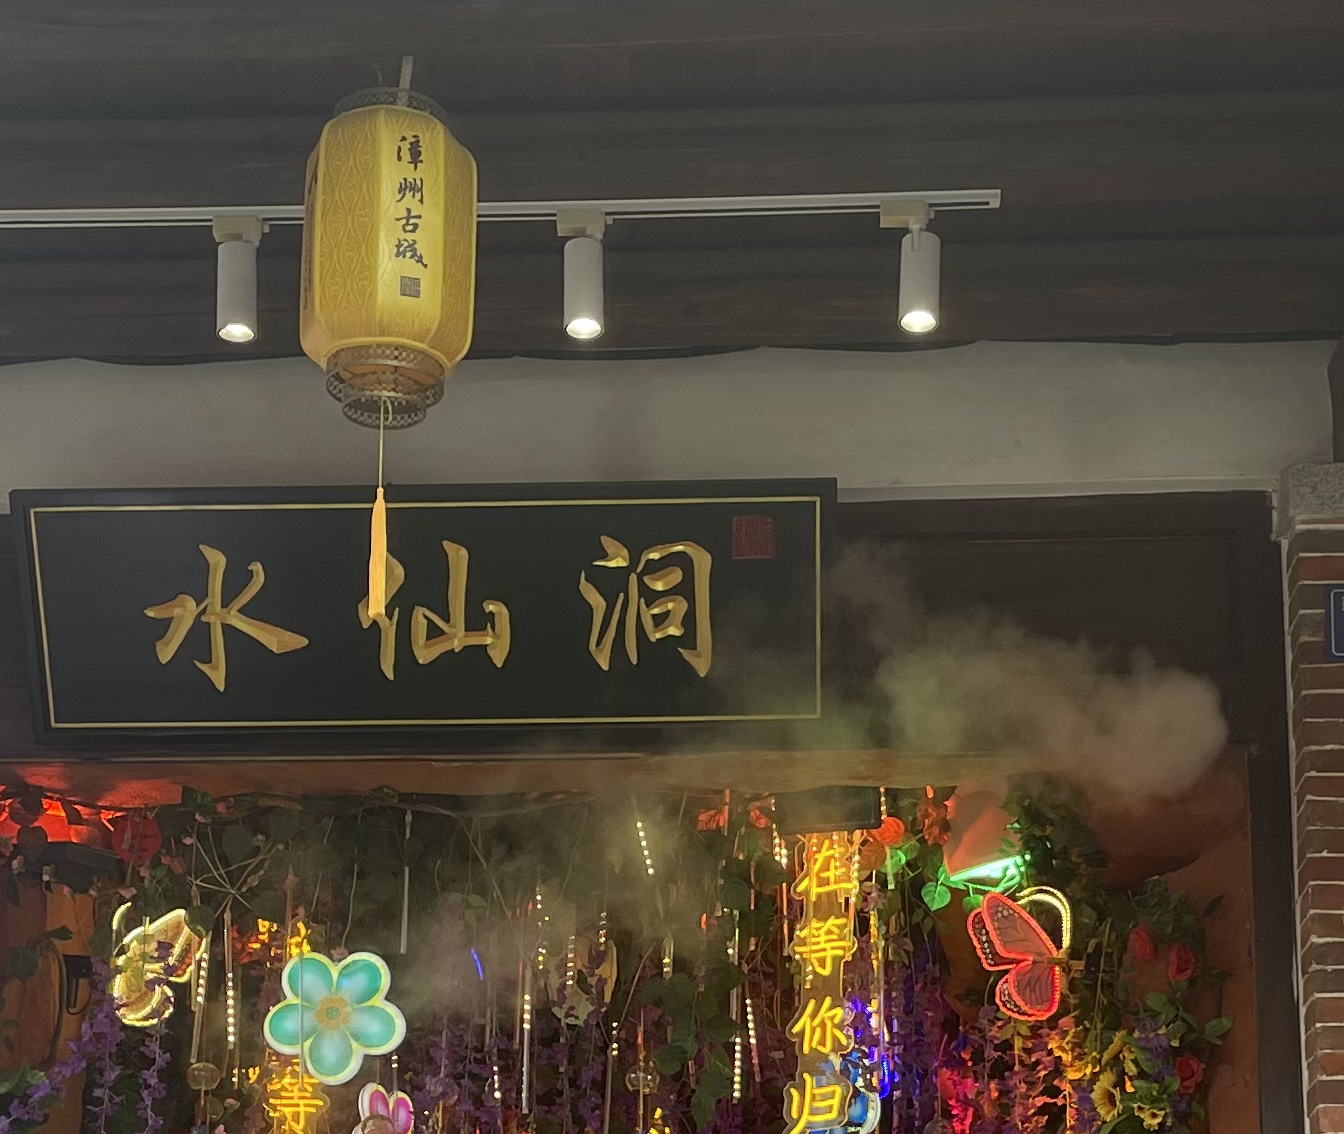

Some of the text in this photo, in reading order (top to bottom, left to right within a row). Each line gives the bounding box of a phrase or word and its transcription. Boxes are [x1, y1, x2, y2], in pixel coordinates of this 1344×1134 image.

[394, 134, 428, 269] 漳州古城
[143, 534, 713, 693] 水仙洞
